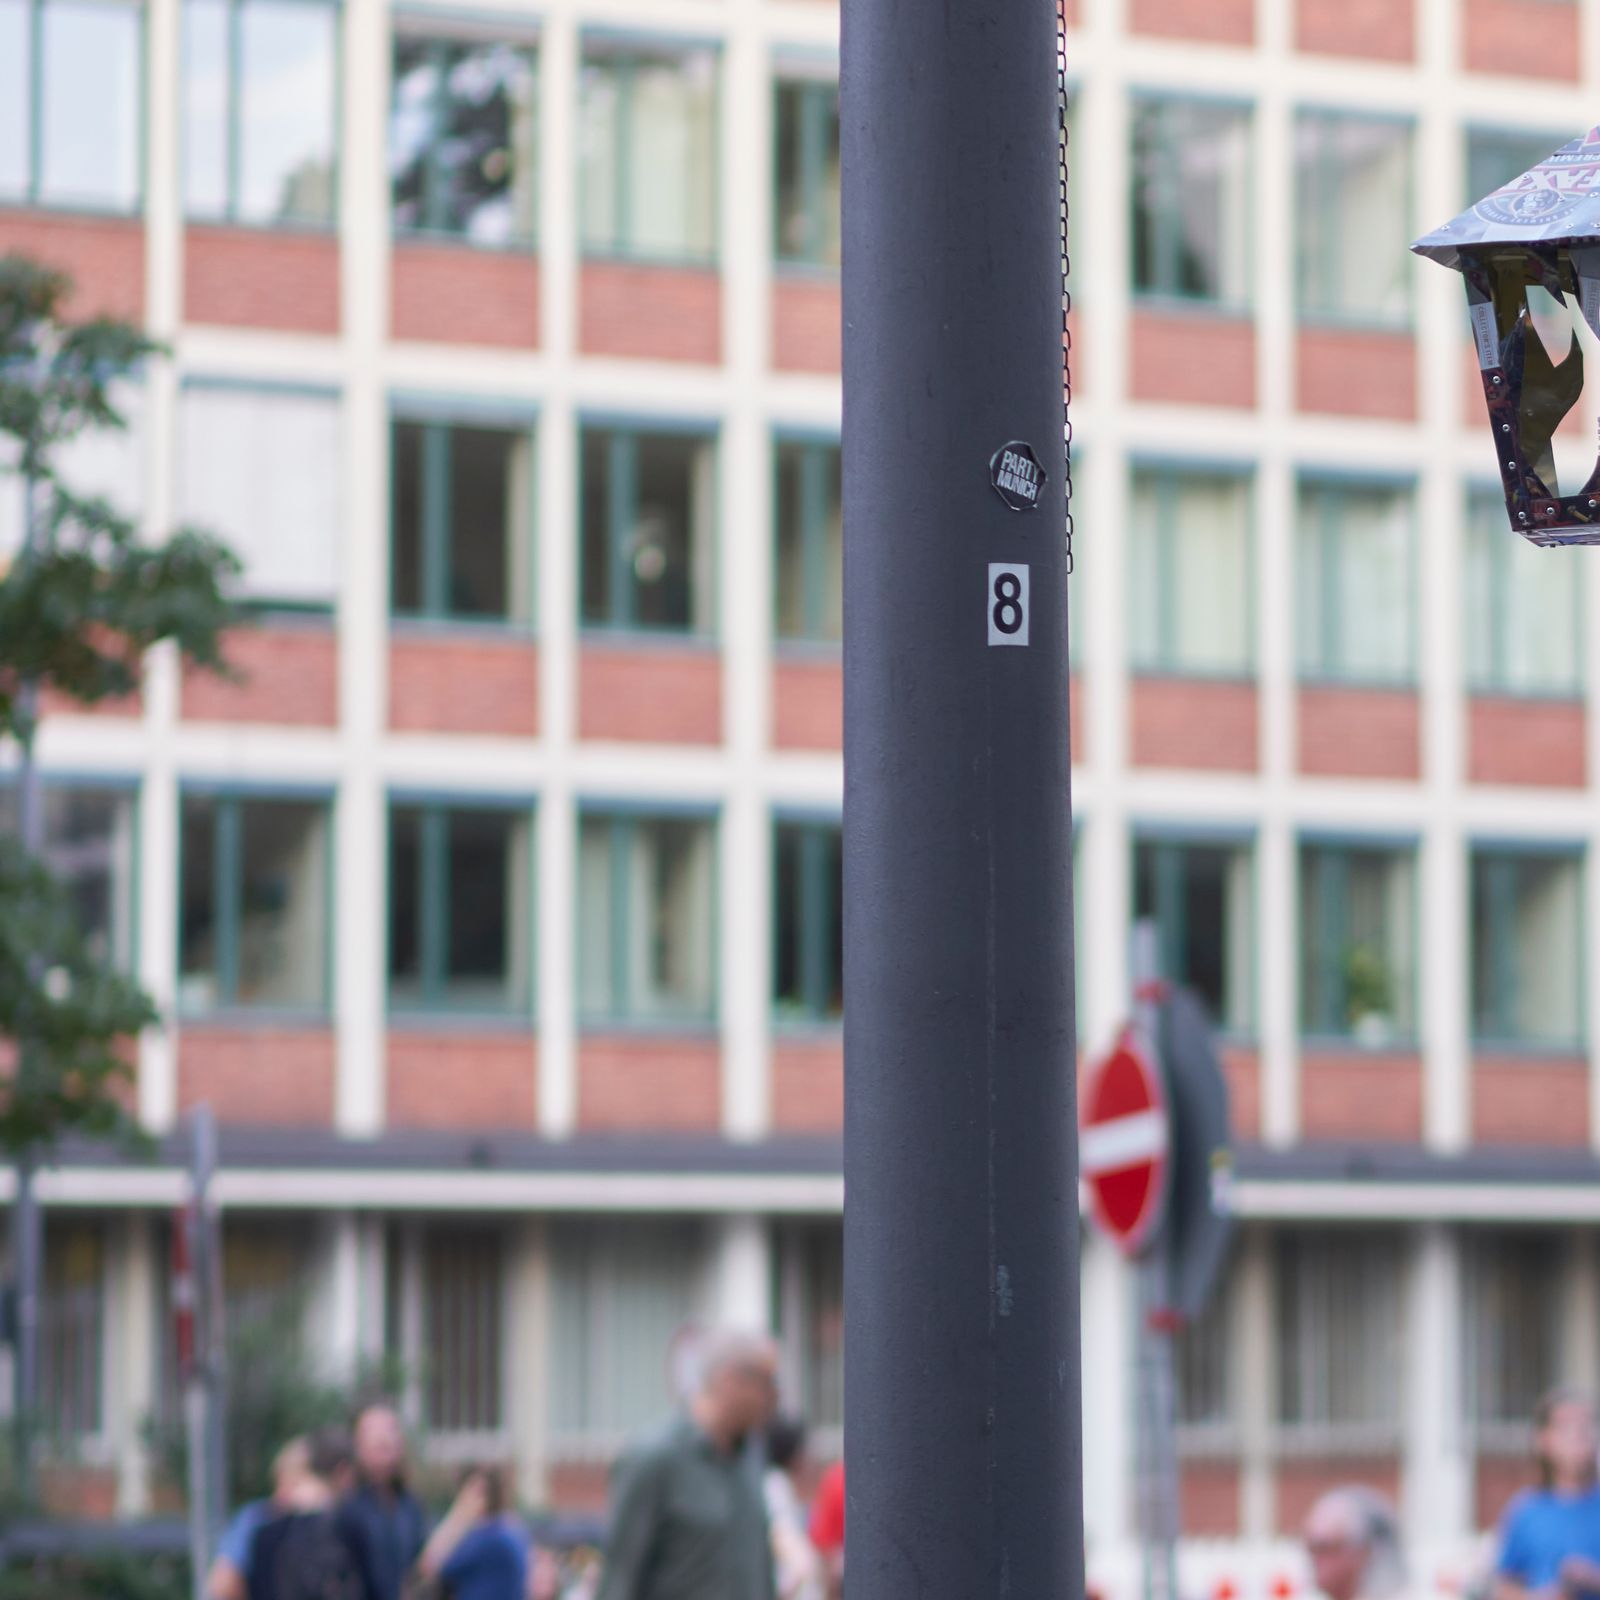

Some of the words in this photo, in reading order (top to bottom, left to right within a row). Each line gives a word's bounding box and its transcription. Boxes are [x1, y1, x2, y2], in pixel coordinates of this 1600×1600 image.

[1001, 450, 1037, 484] PARTY
[997, 469, 1038, 501] MUNICH
[993, 572, 1023, 635] 8
